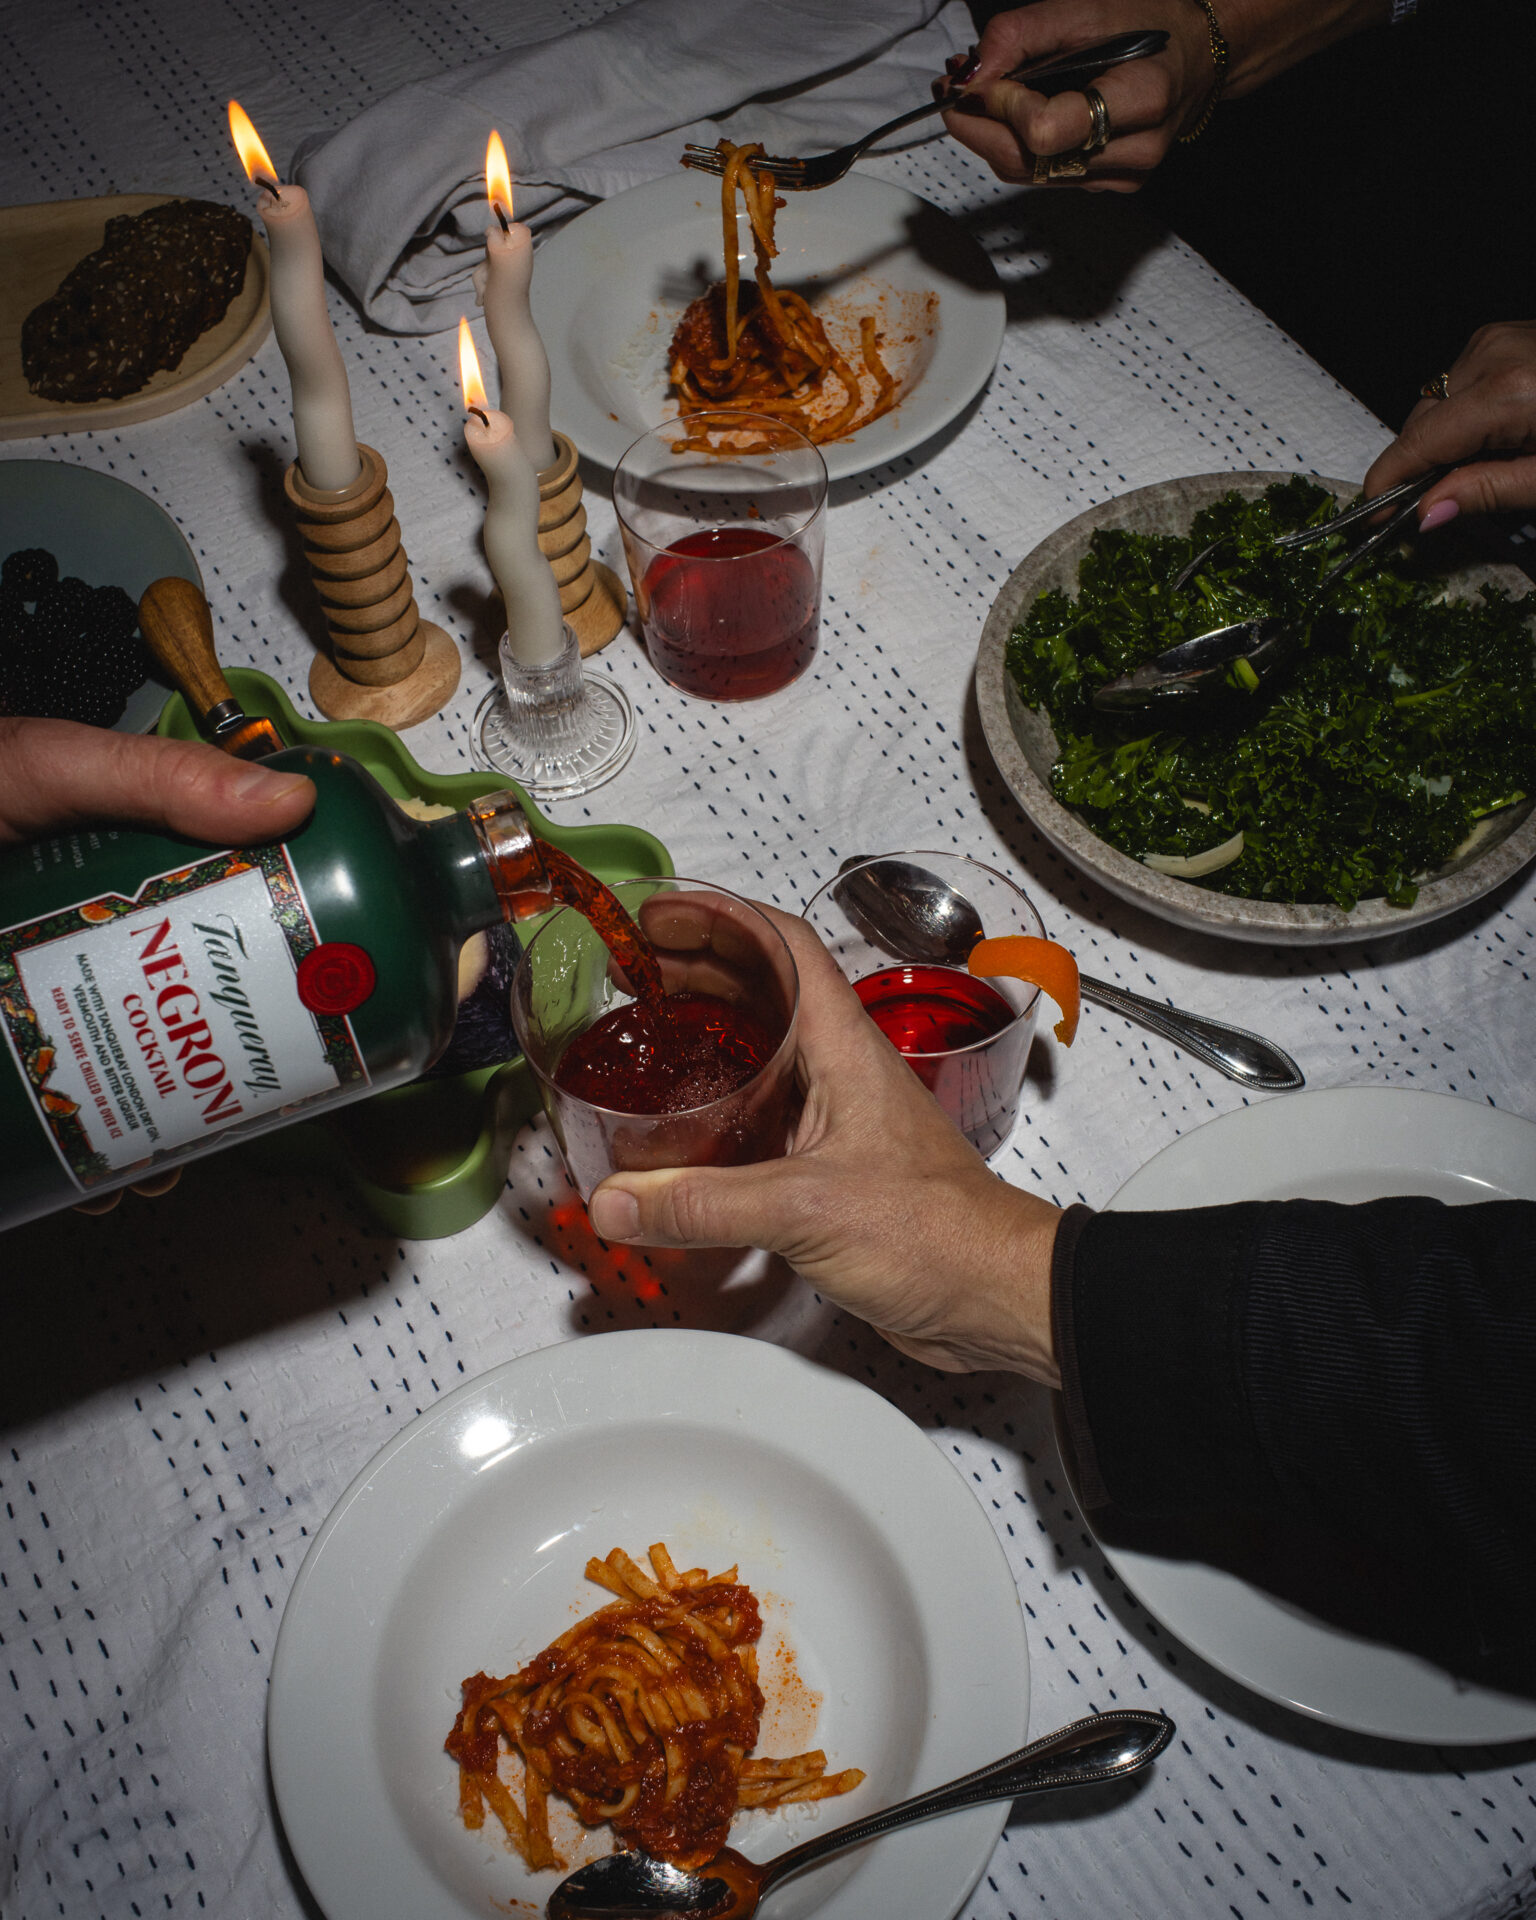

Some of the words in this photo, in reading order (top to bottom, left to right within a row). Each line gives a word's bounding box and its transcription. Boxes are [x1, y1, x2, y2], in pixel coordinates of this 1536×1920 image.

[52, 987, 70, 1015] READY
[192, 914, 283, 1093] Tanqueray
[62, 1017, 76, 1030] TO
[130, 918, 245, 1127] NEGRONI
[68, 1032, 88, 1060] SERVE
[76, 952, 95, 983] MADE
[88, 984, 105, 1012] WITH
[98, 1012, 129, 1071] TANQUERAY
[122, 1072, 147, 1112] LONDON
[139, 1112, 154, 1126] DRY
[123, 994, 177, 1099] COCKTAIL
[73, 984, 102, 1042] VERMOUTH
[94, 1044, 111, 1066] AND
[104, 1067, 124, 1096] BITTER
[117, 1096, 140, 1131] LIQUEUR
[80, 1061, 102, 1095] CHILLED
[94, 1096, 108, 1107] OR
[100, 1108, 117, 1127] OVER
[109, 1127, 123, 1139] ICE
